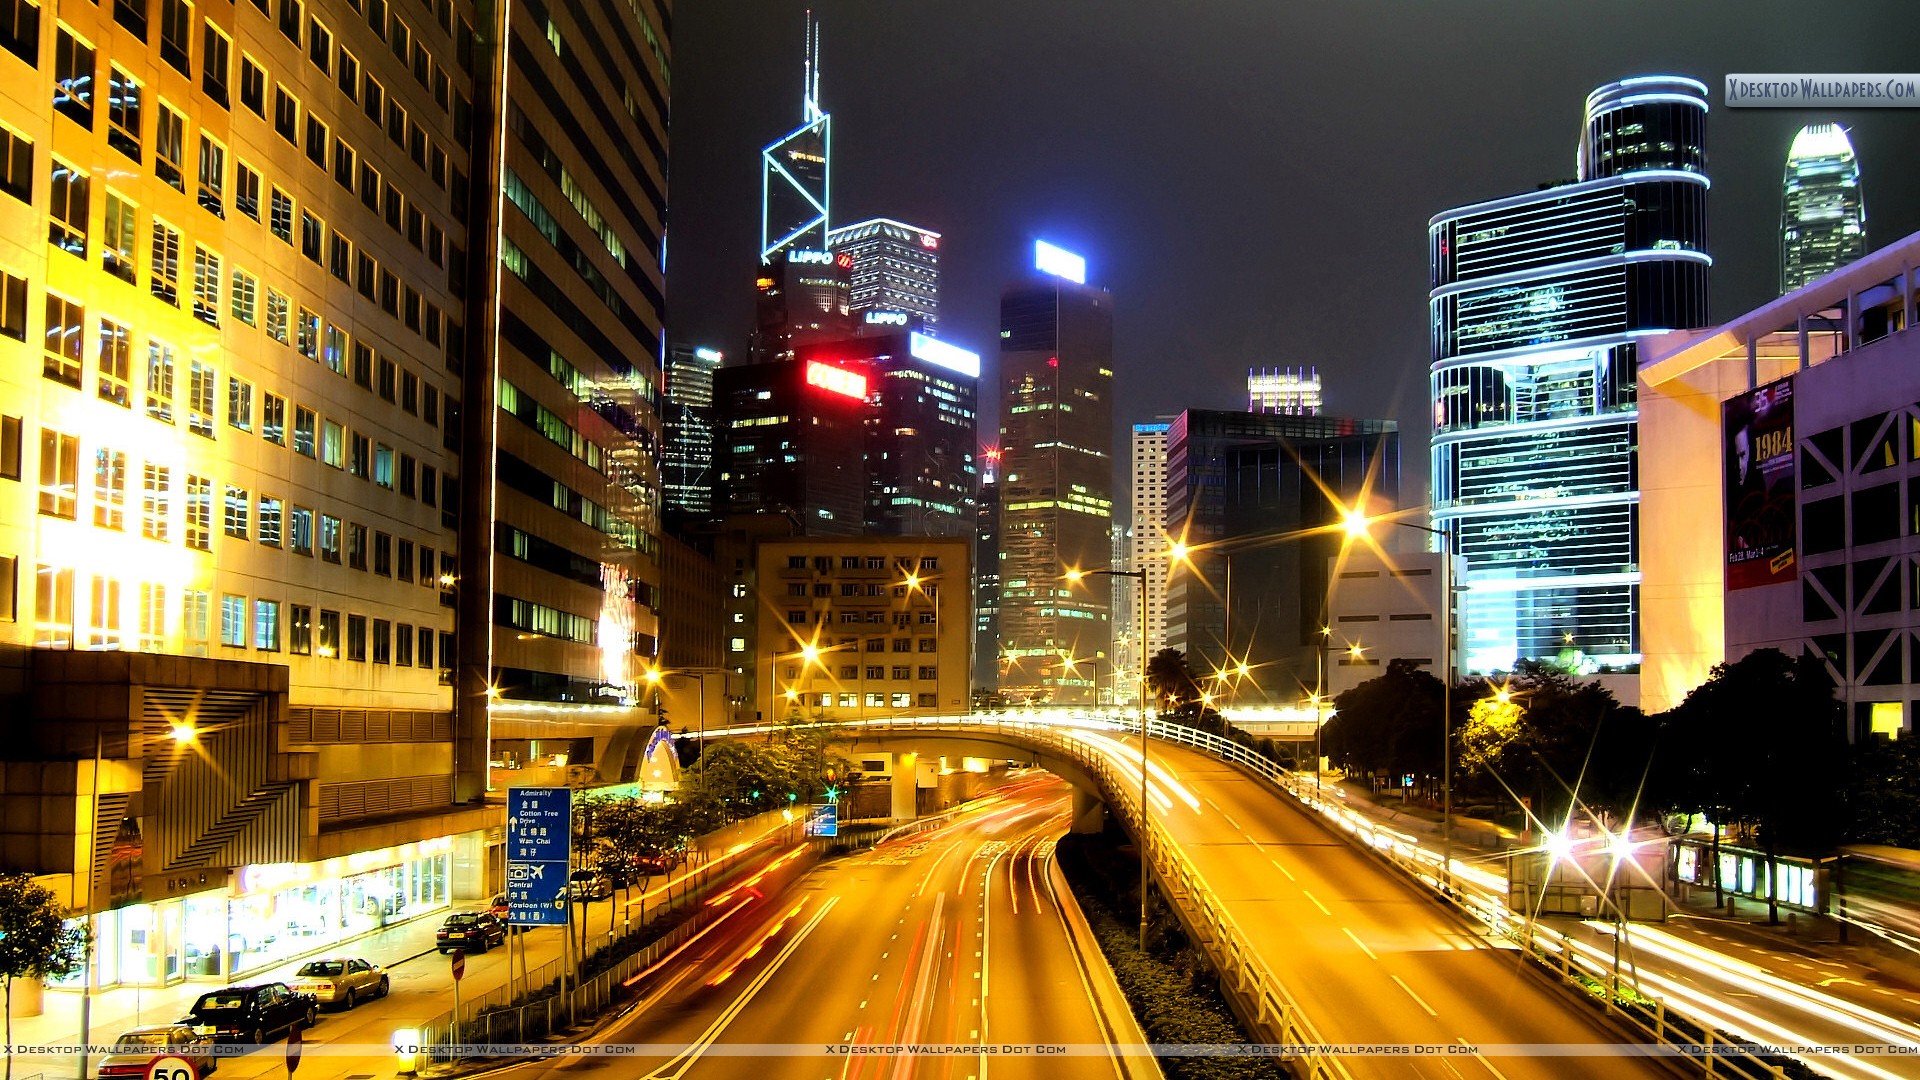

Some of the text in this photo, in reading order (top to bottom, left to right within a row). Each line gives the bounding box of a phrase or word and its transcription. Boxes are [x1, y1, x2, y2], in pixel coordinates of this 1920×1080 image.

[789, 250, 834, 264] LIPPO
[866, 312, 908, 326] LIPPO
[1755, 426, 1793, 462] 1984
[1729, 552, 1738, 563] Feb
[519, 790, 552, 798] Admiralty
